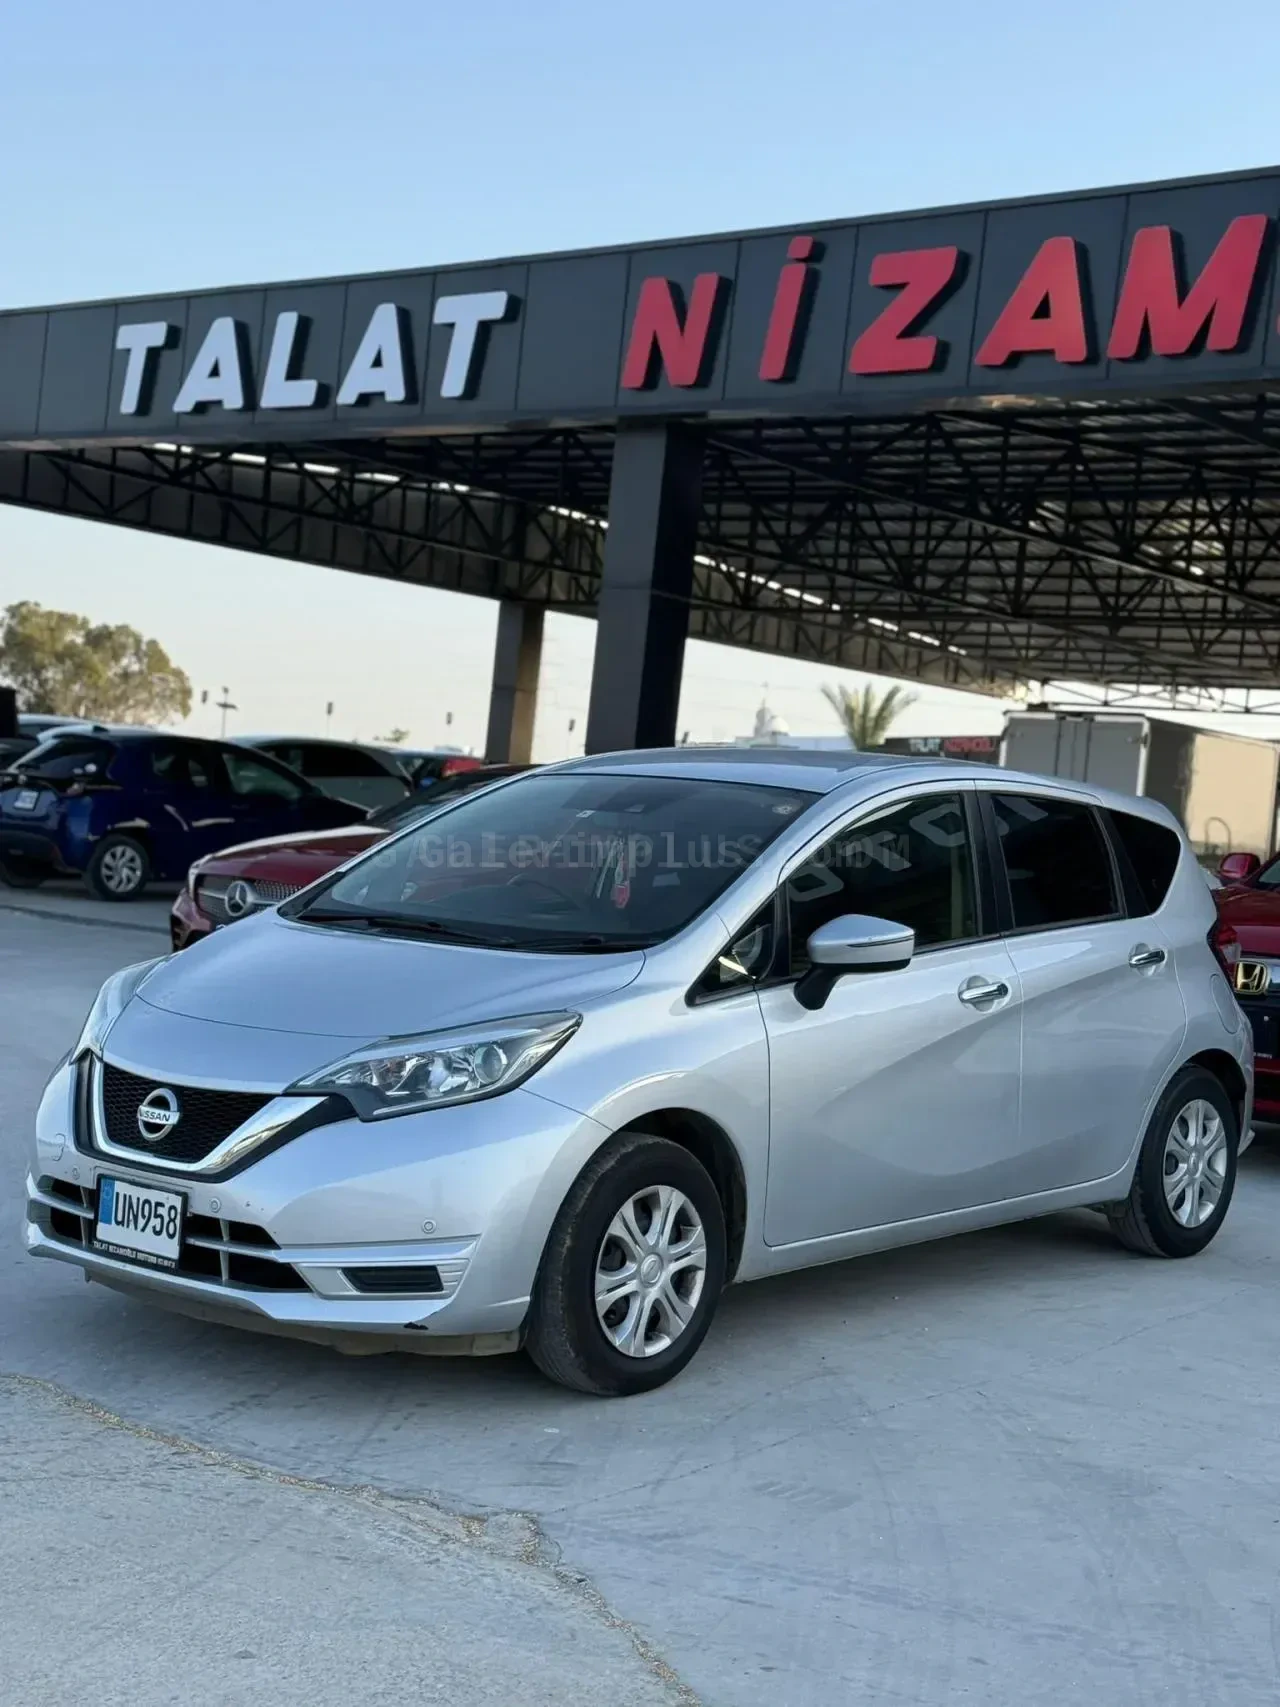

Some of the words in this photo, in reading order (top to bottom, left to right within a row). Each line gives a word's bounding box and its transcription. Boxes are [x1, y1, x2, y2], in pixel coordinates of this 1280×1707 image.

[116, 291, 508, 414] TALAT
[620, 214, 1280, 389] NİZAM
[114, 1191, 178, 1240] UN958
